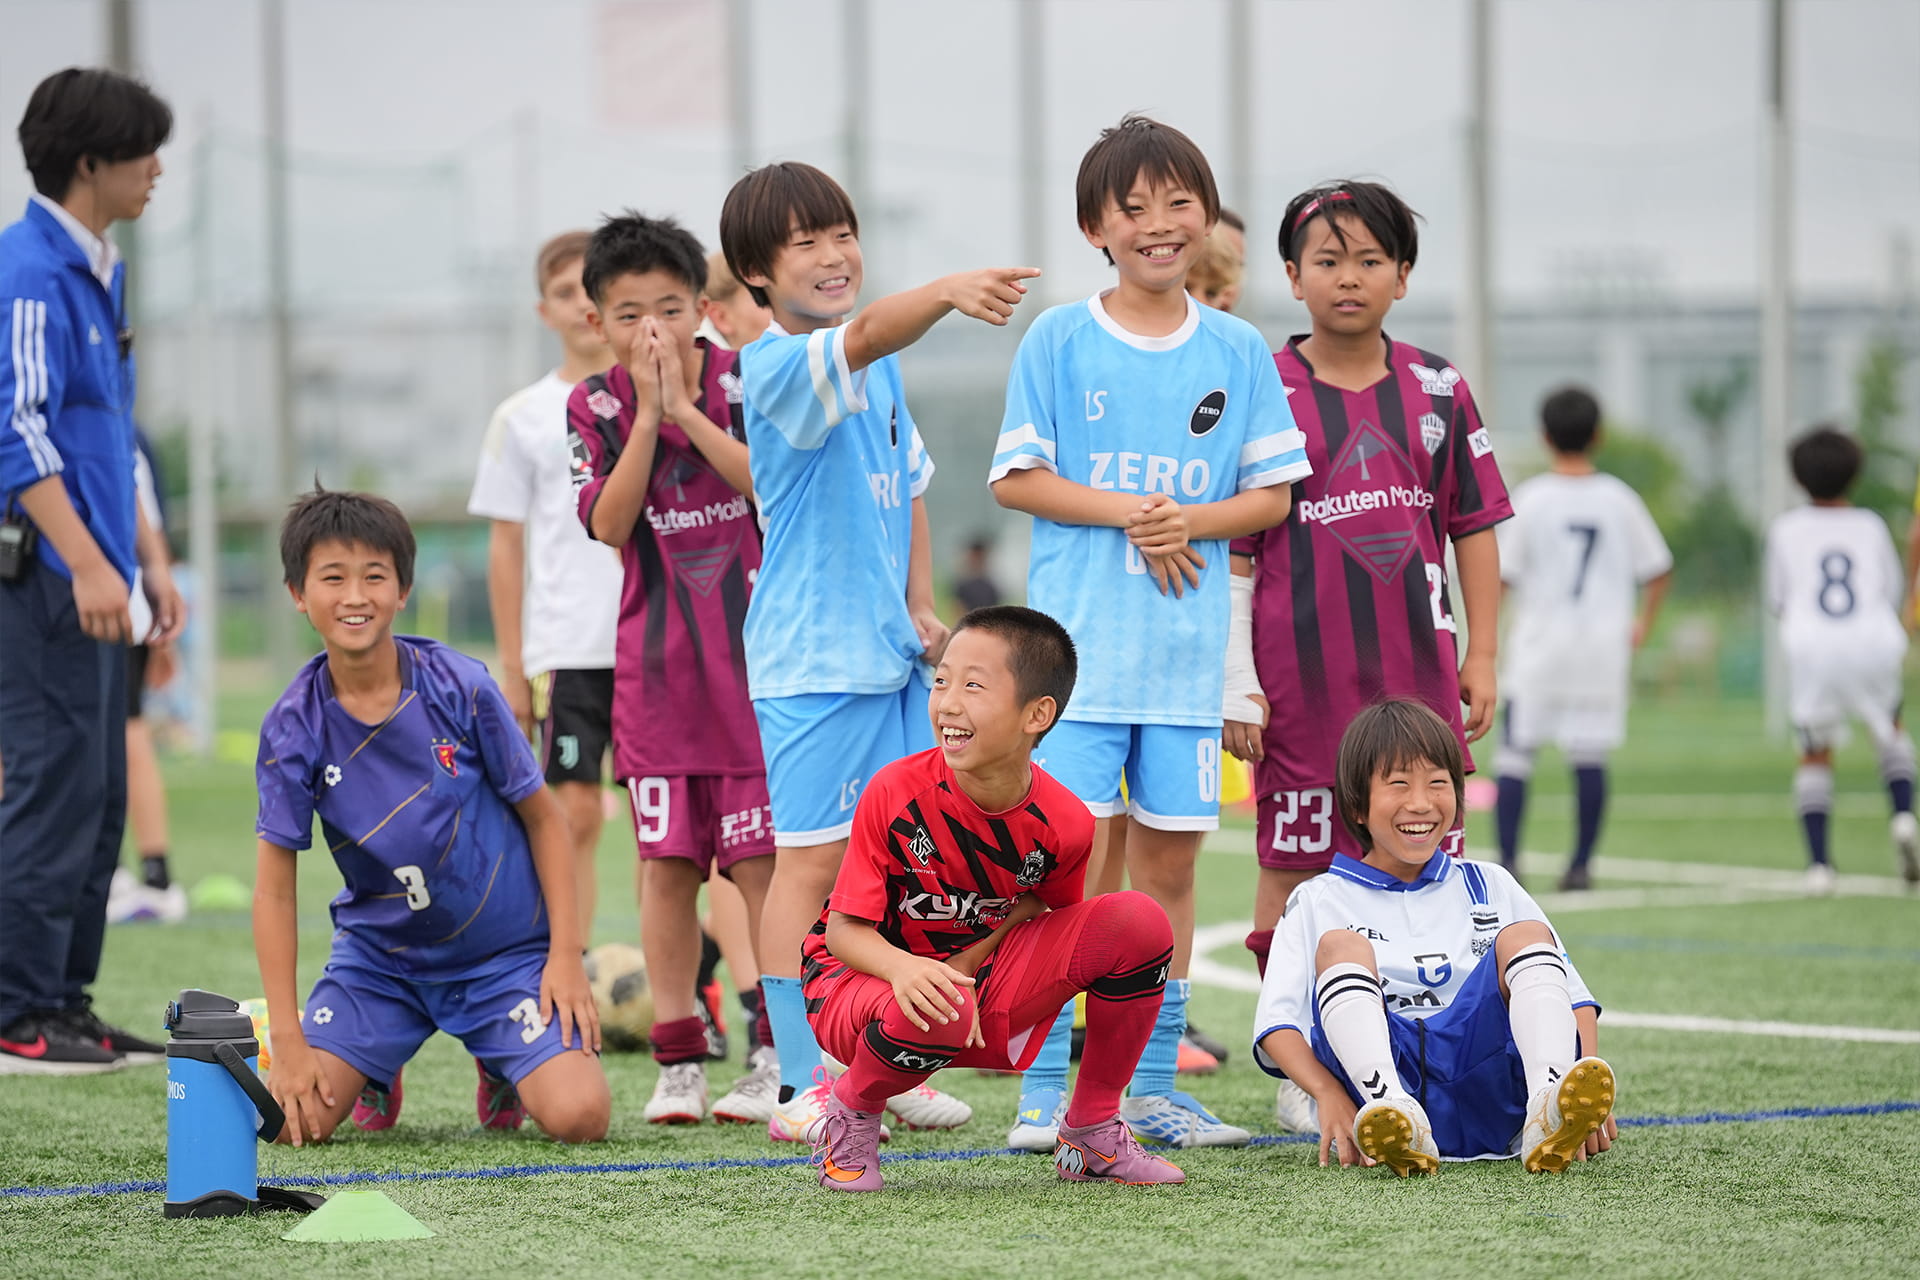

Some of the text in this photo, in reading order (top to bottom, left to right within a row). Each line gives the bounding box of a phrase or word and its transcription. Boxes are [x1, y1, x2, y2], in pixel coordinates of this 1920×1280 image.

[1199, 405, 1220, 417] ZERO
[1089, 451, 1210, 498] ZERO
[1299, 488, 1390, 526] Rakuten
[1567, 524, 1599, 600] 7
[1818, 550, 1855, 618] 8
[1424, 562, 1457, 634] 2
[1272, 786, 1334, 854] 23
[392, 864, 431, 912] 3
[953, 917, 978, 929] CITY
[507, 997, 548, 1045] 3
